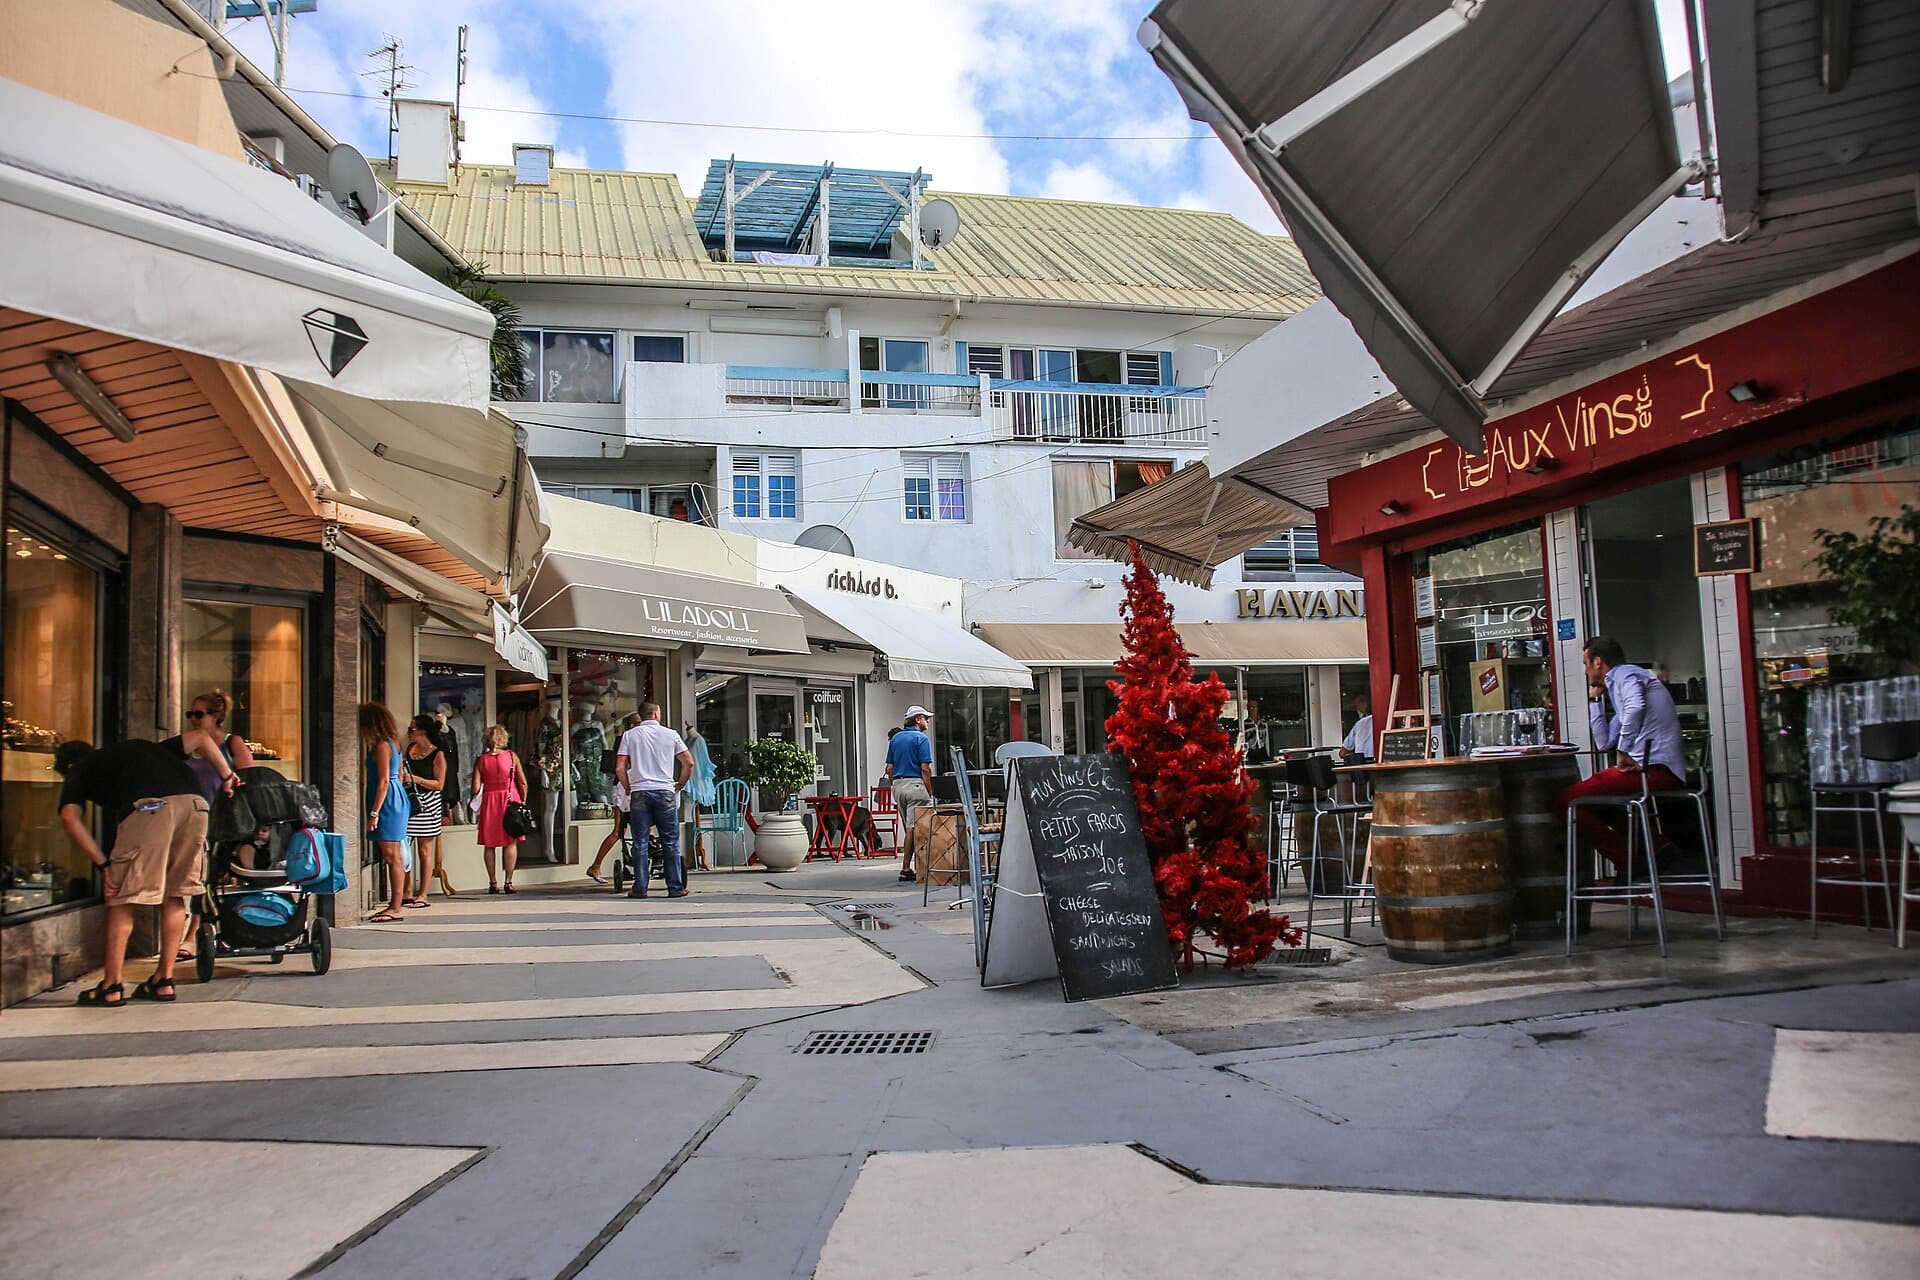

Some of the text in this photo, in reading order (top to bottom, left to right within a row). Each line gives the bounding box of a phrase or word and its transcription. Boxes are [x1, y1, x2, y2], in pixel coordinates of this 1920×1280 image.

[1489, 427, 1555, 480] Aux
[1556, 395, 1638, 452] Vins
[641, 598, 759, 633] LILADOLL
[1234, 588, 1367, 619] HAVAN
[812, 690, 842, 703] coiffure
